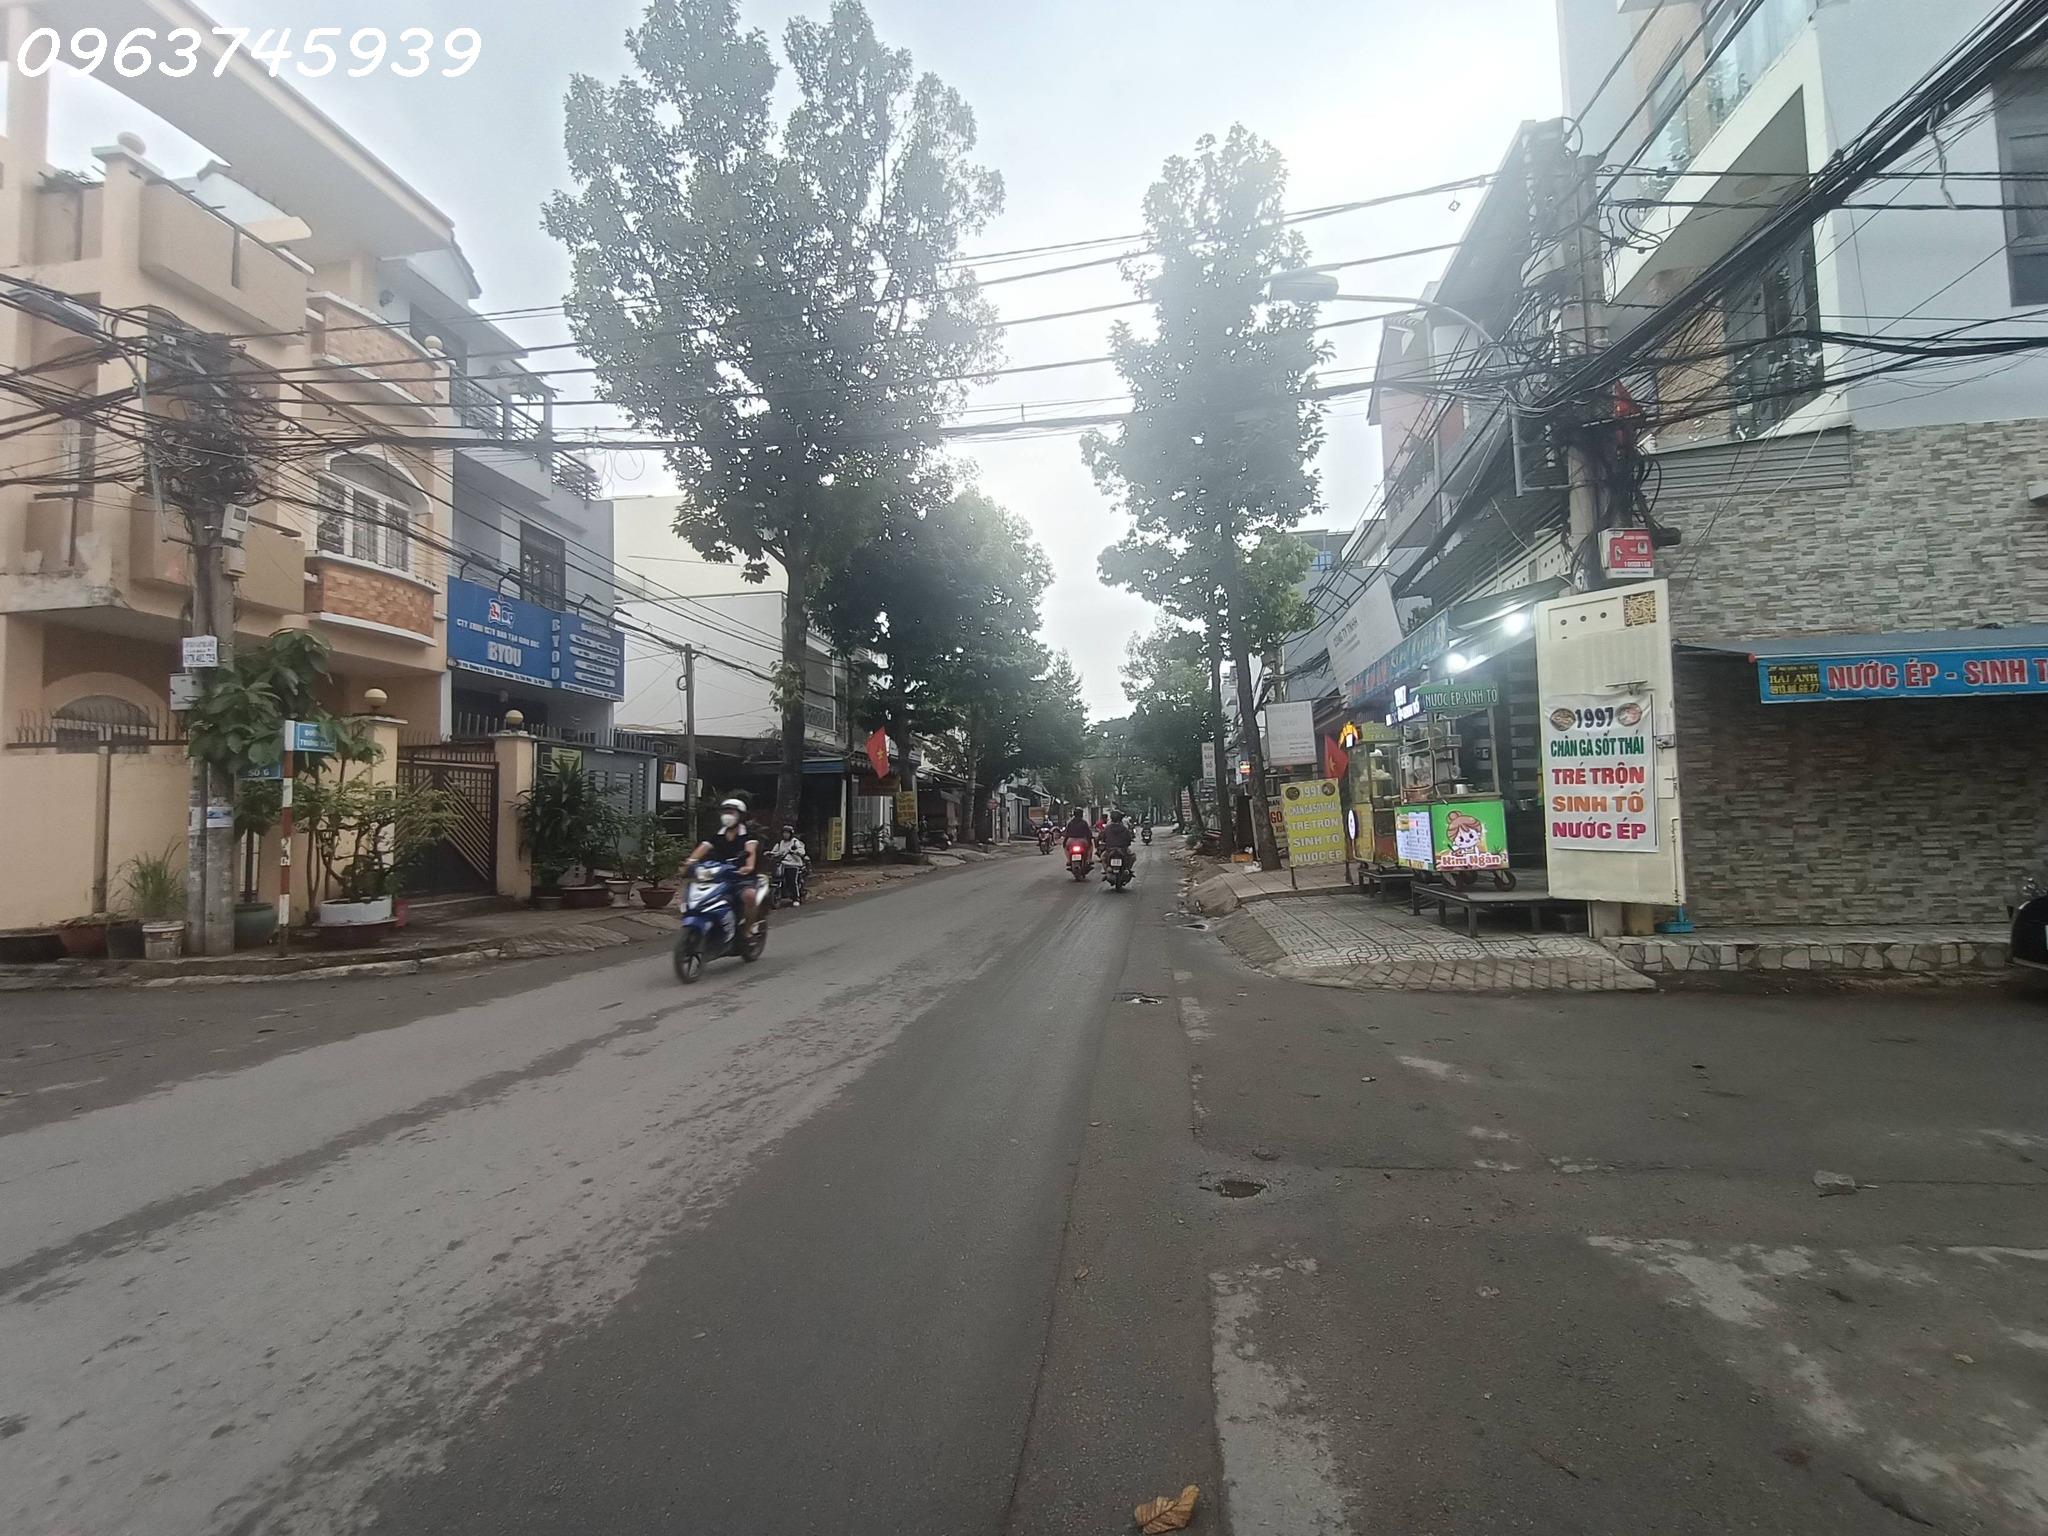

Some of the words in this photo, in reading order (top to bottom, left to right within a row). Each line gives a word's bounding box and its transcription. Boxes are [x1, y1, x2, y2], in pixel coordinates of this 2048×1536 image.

[487, 641, 522, 667] BYOU
[1827, 658, 1898, 691] NƯỚC
[1904, 657, 1938, 688] ÉP
[1963, 658, 2028, 686] SINH
[2033, 657, 2048, 683] T
[1575, 706, 1614, 729] 1997
[1550, 735, 1578, 757] CHÂN
[1579, 732, 1594, 756] GÀ
[1595, 730, 1617, 756] SỐT
[1617, 730, 1645, 755] THÁI
[1552, 762, 1586, 785] TRÉ
[1589, 762, 1645, 789] TRỘN
[1552, 795, 1608, 813] SINH
[1612, 788, 1645, 813] TỐ
[1552, 816, 1612, 839] NƯỚC
[1616, 816, 1647, 839] ÉP
[1293, 836, 1322, 848] SINH
[1442, 856, 1467, 867] Kim
